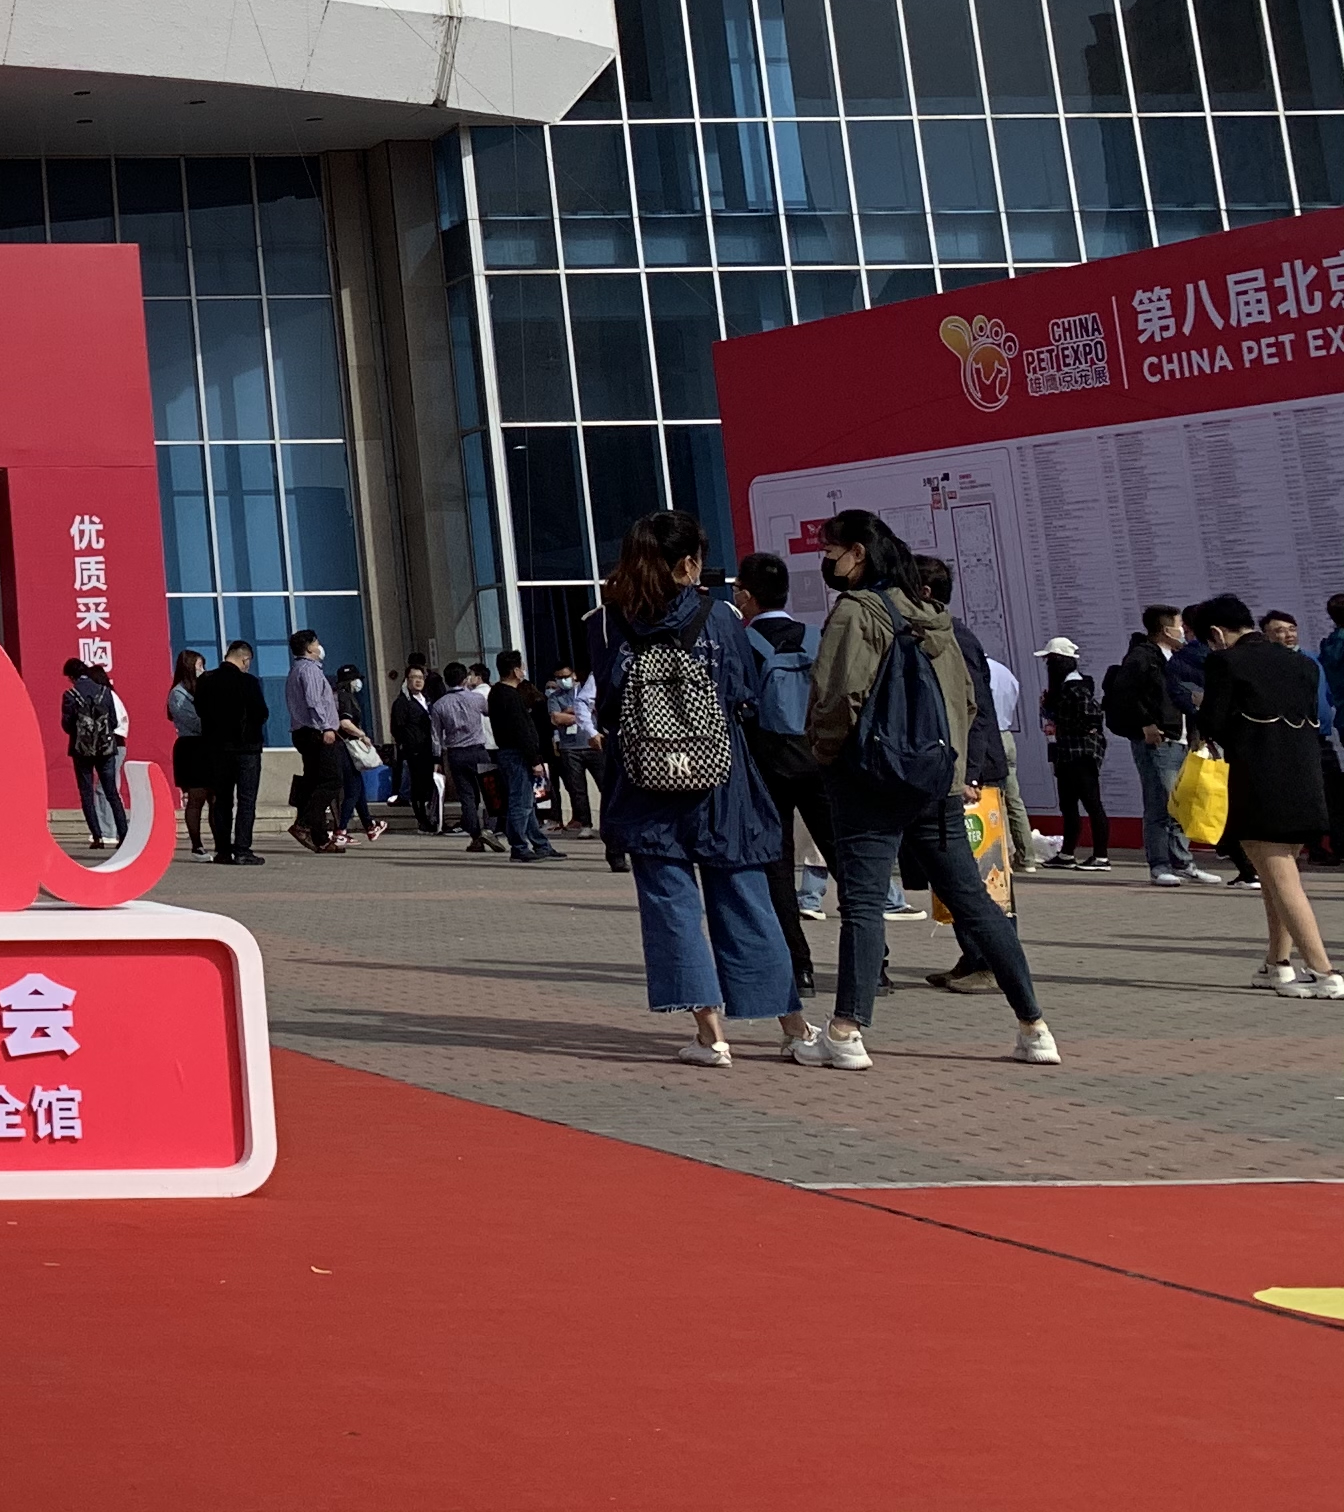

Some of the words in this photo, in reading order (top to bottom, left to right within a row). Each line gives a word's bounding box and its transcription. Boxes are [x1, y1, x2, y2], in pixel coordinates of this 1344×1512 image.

[1049, 312, 1104, 345] CHINA
[1023, 347, 1058, 375] PET
[1061, 339, 1107, 368] EXPO
[1143, 345, 1233, 383] CHINA
[1241, 333, 1296, 368] PET
